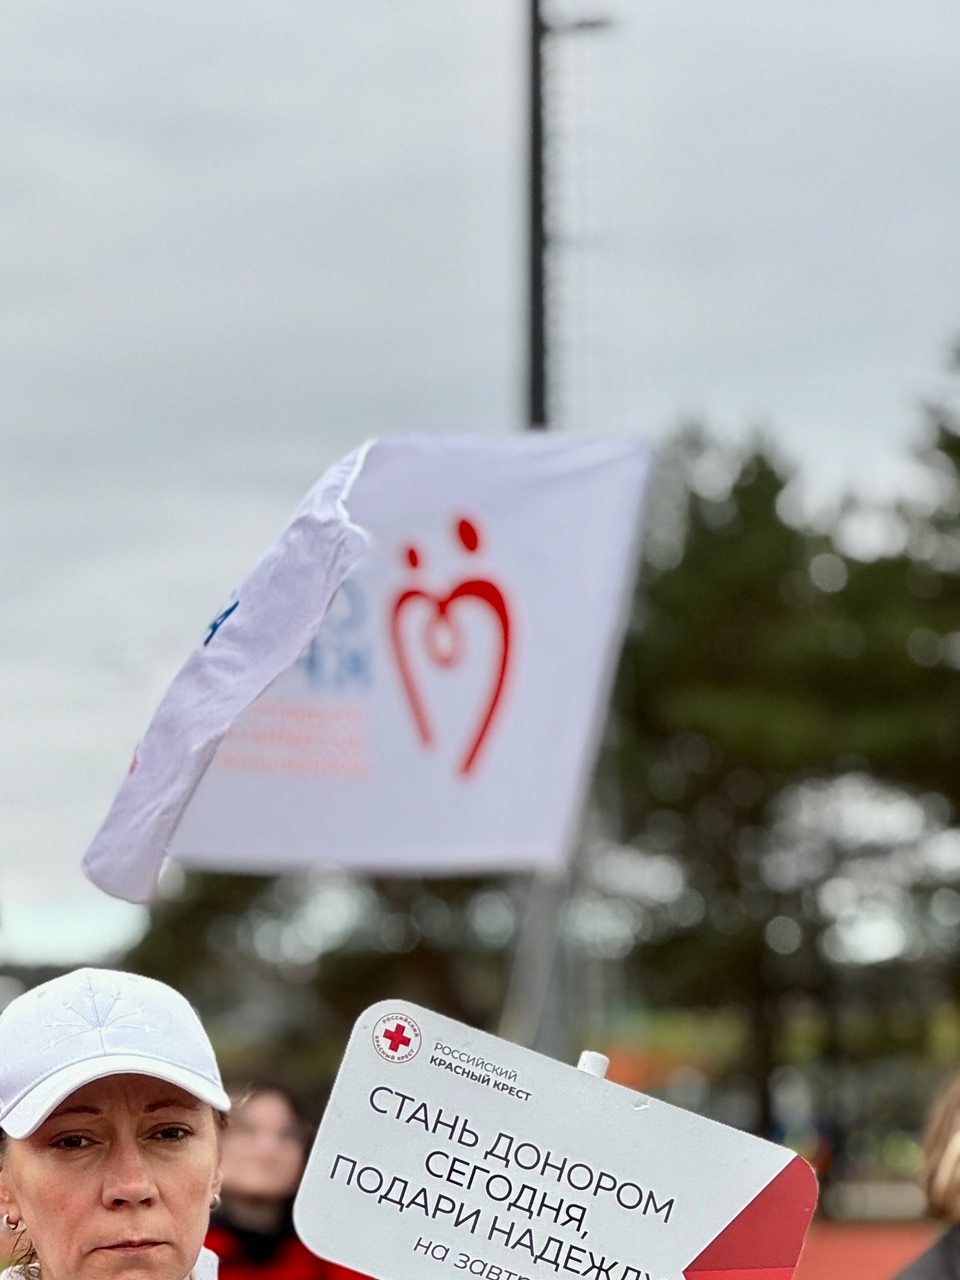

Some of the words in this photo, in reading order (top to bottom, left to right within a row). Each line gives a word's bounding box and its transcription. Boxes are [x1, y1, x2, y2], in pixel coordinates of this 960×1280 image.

[374, 1035, 395, 1060] КРАСНЫЙ
[397, 1048, 415, 1061] КРЕСТ
[382, 1015, 420, 1038] РОССИЙСКИЙ
[429, 1055, 491, 1086] КРАСНЫЙ
[493, 1080, 532, 1102] КРЕСТ
[434, 1042, 518, 1082] РОССИЙСКИЙ
[369, 1086, 479, 1148] СТАНЬ
[483, 1132, 675, 1223] ДОНОРОМ
[329, 1154, 481, 1234] ПОДАРИ
[425, 1151, 589, 1239] СЕГОДНЯ,
[413, 1237, 450, 1262] на
